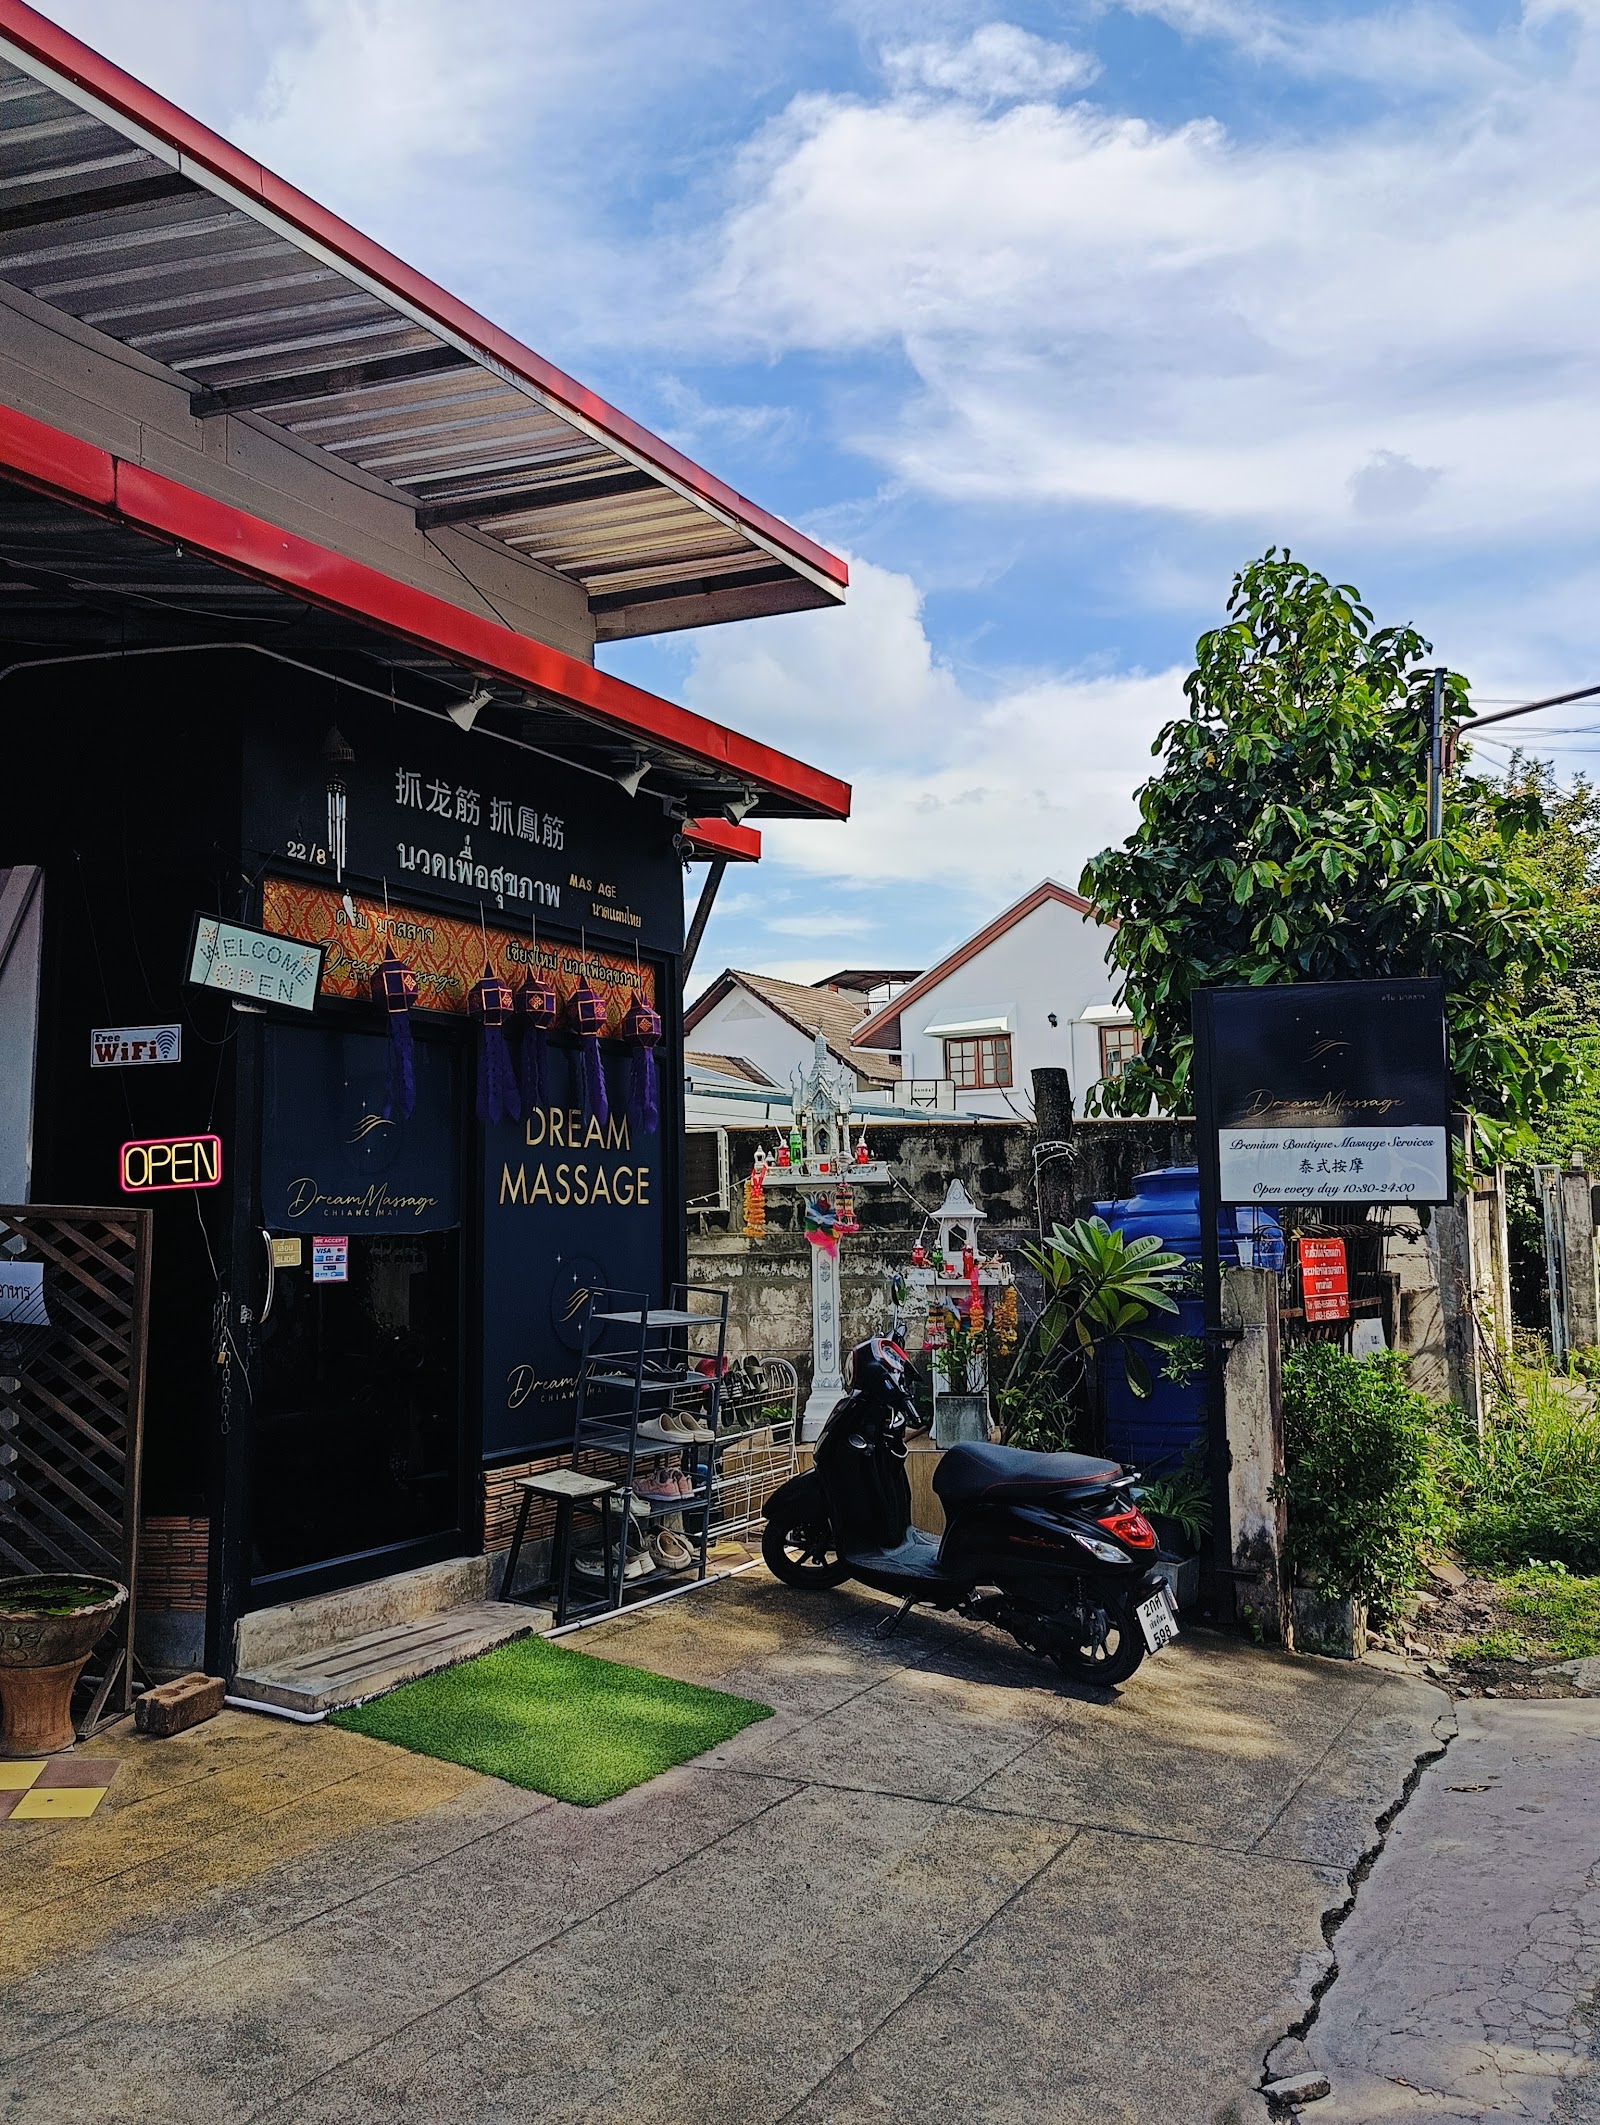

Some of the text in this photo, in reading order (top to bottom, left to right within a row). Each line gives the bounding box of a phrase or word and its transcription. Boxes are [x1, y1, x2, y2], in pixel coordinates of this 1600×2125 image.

[395, 767, 565, 851] 抓龙筋 抓鳳筋
[287, 841, 326, 865] 22/8
[397, 835, 561, 909] นวดเพื่อสุขภาพ
[200, 938, 314, 987] WELCOME
[506, 941, 557, 970] เชียงใหม่
[214, 964, 296, 1002] OPEN
[94, 1033, 121, 1043] Free
[95, 1042, 157, 1063] WiFi
[526, 1106, 631, 1151] DREAM
[1229, 1136, 1435, 1152] Premium Boutique Massage Services
[125, 1141, 217, 1186] OPEN
[1299, 1158, 1364, 1174] 泰式按摩
[499, 1161, 651, 1206] MASSAGE
[1252, 1182, 1282, 1198] Open
[1283, 1185, 1315, 1198] every
[1317, 1182, 1340, 1197] day
[323, 1209, 399, 1217] CHIANG MAI
[276, 1255, 296, 1263] SLIDE
[1153, 1625, 1172, 1646] 598
